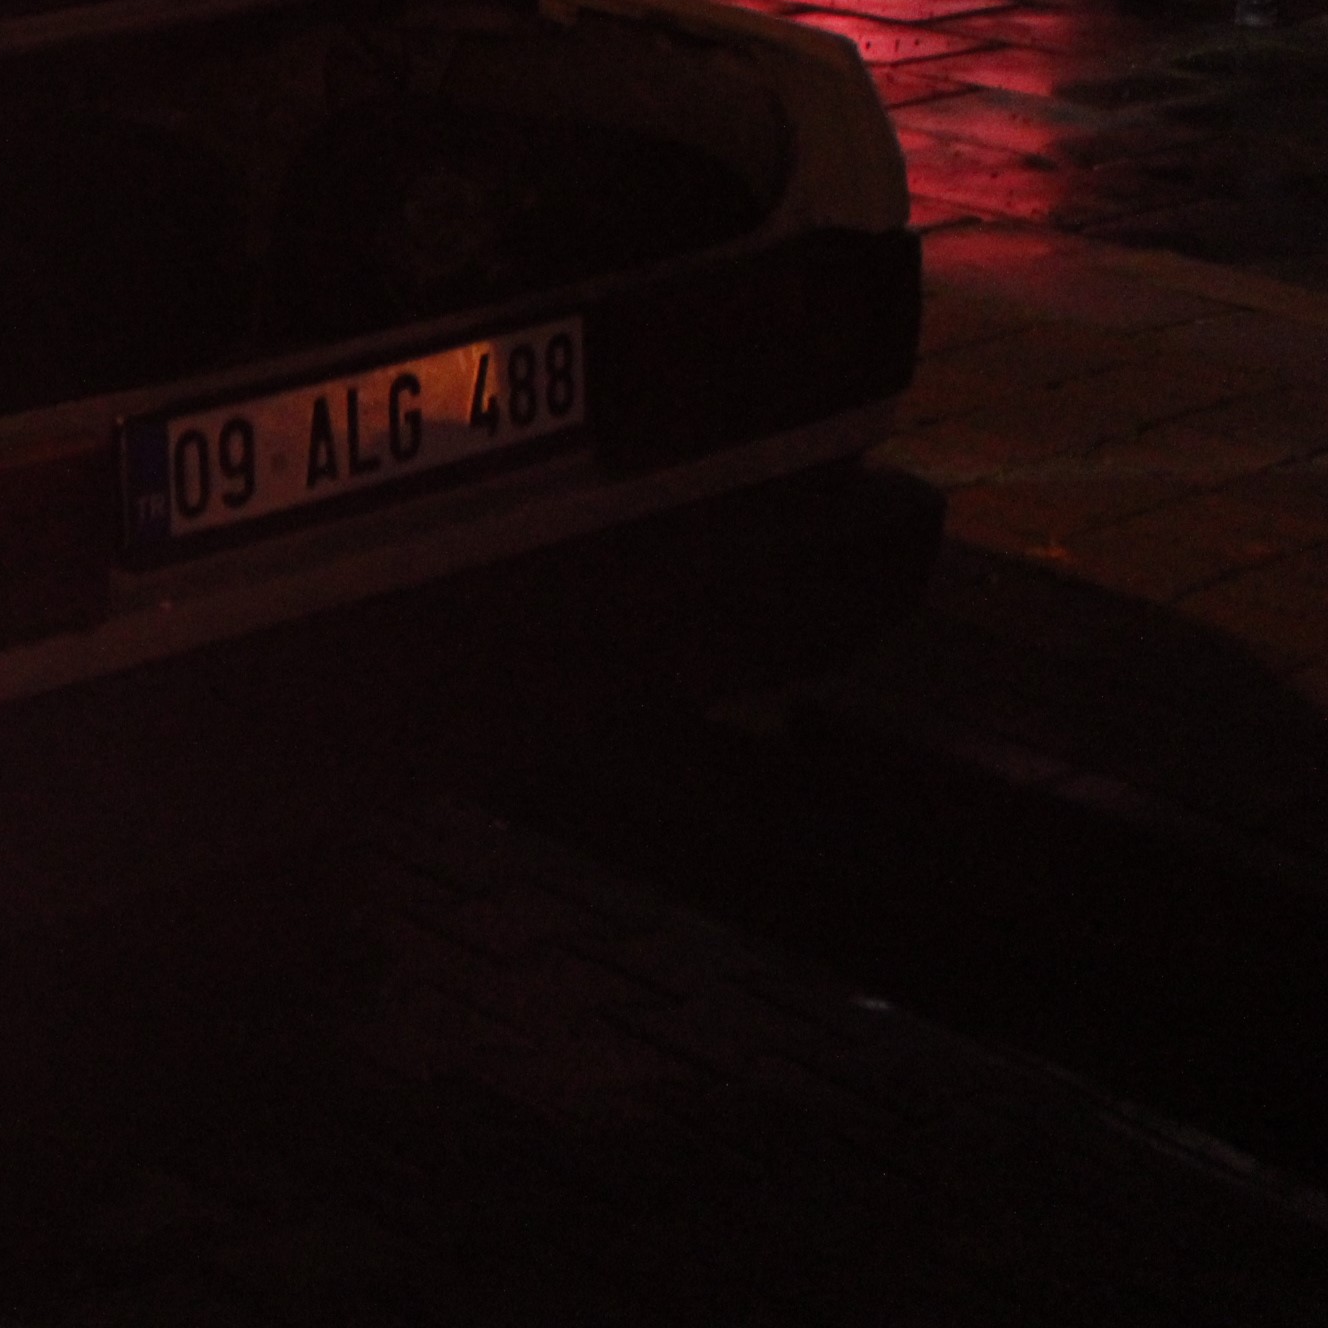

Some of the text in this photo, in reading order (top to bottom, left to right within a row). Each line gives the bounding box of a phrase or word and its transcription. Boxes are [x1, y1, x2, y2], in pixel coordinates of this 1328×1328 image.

[173, 332, 575, 519] 09 ALG 488
